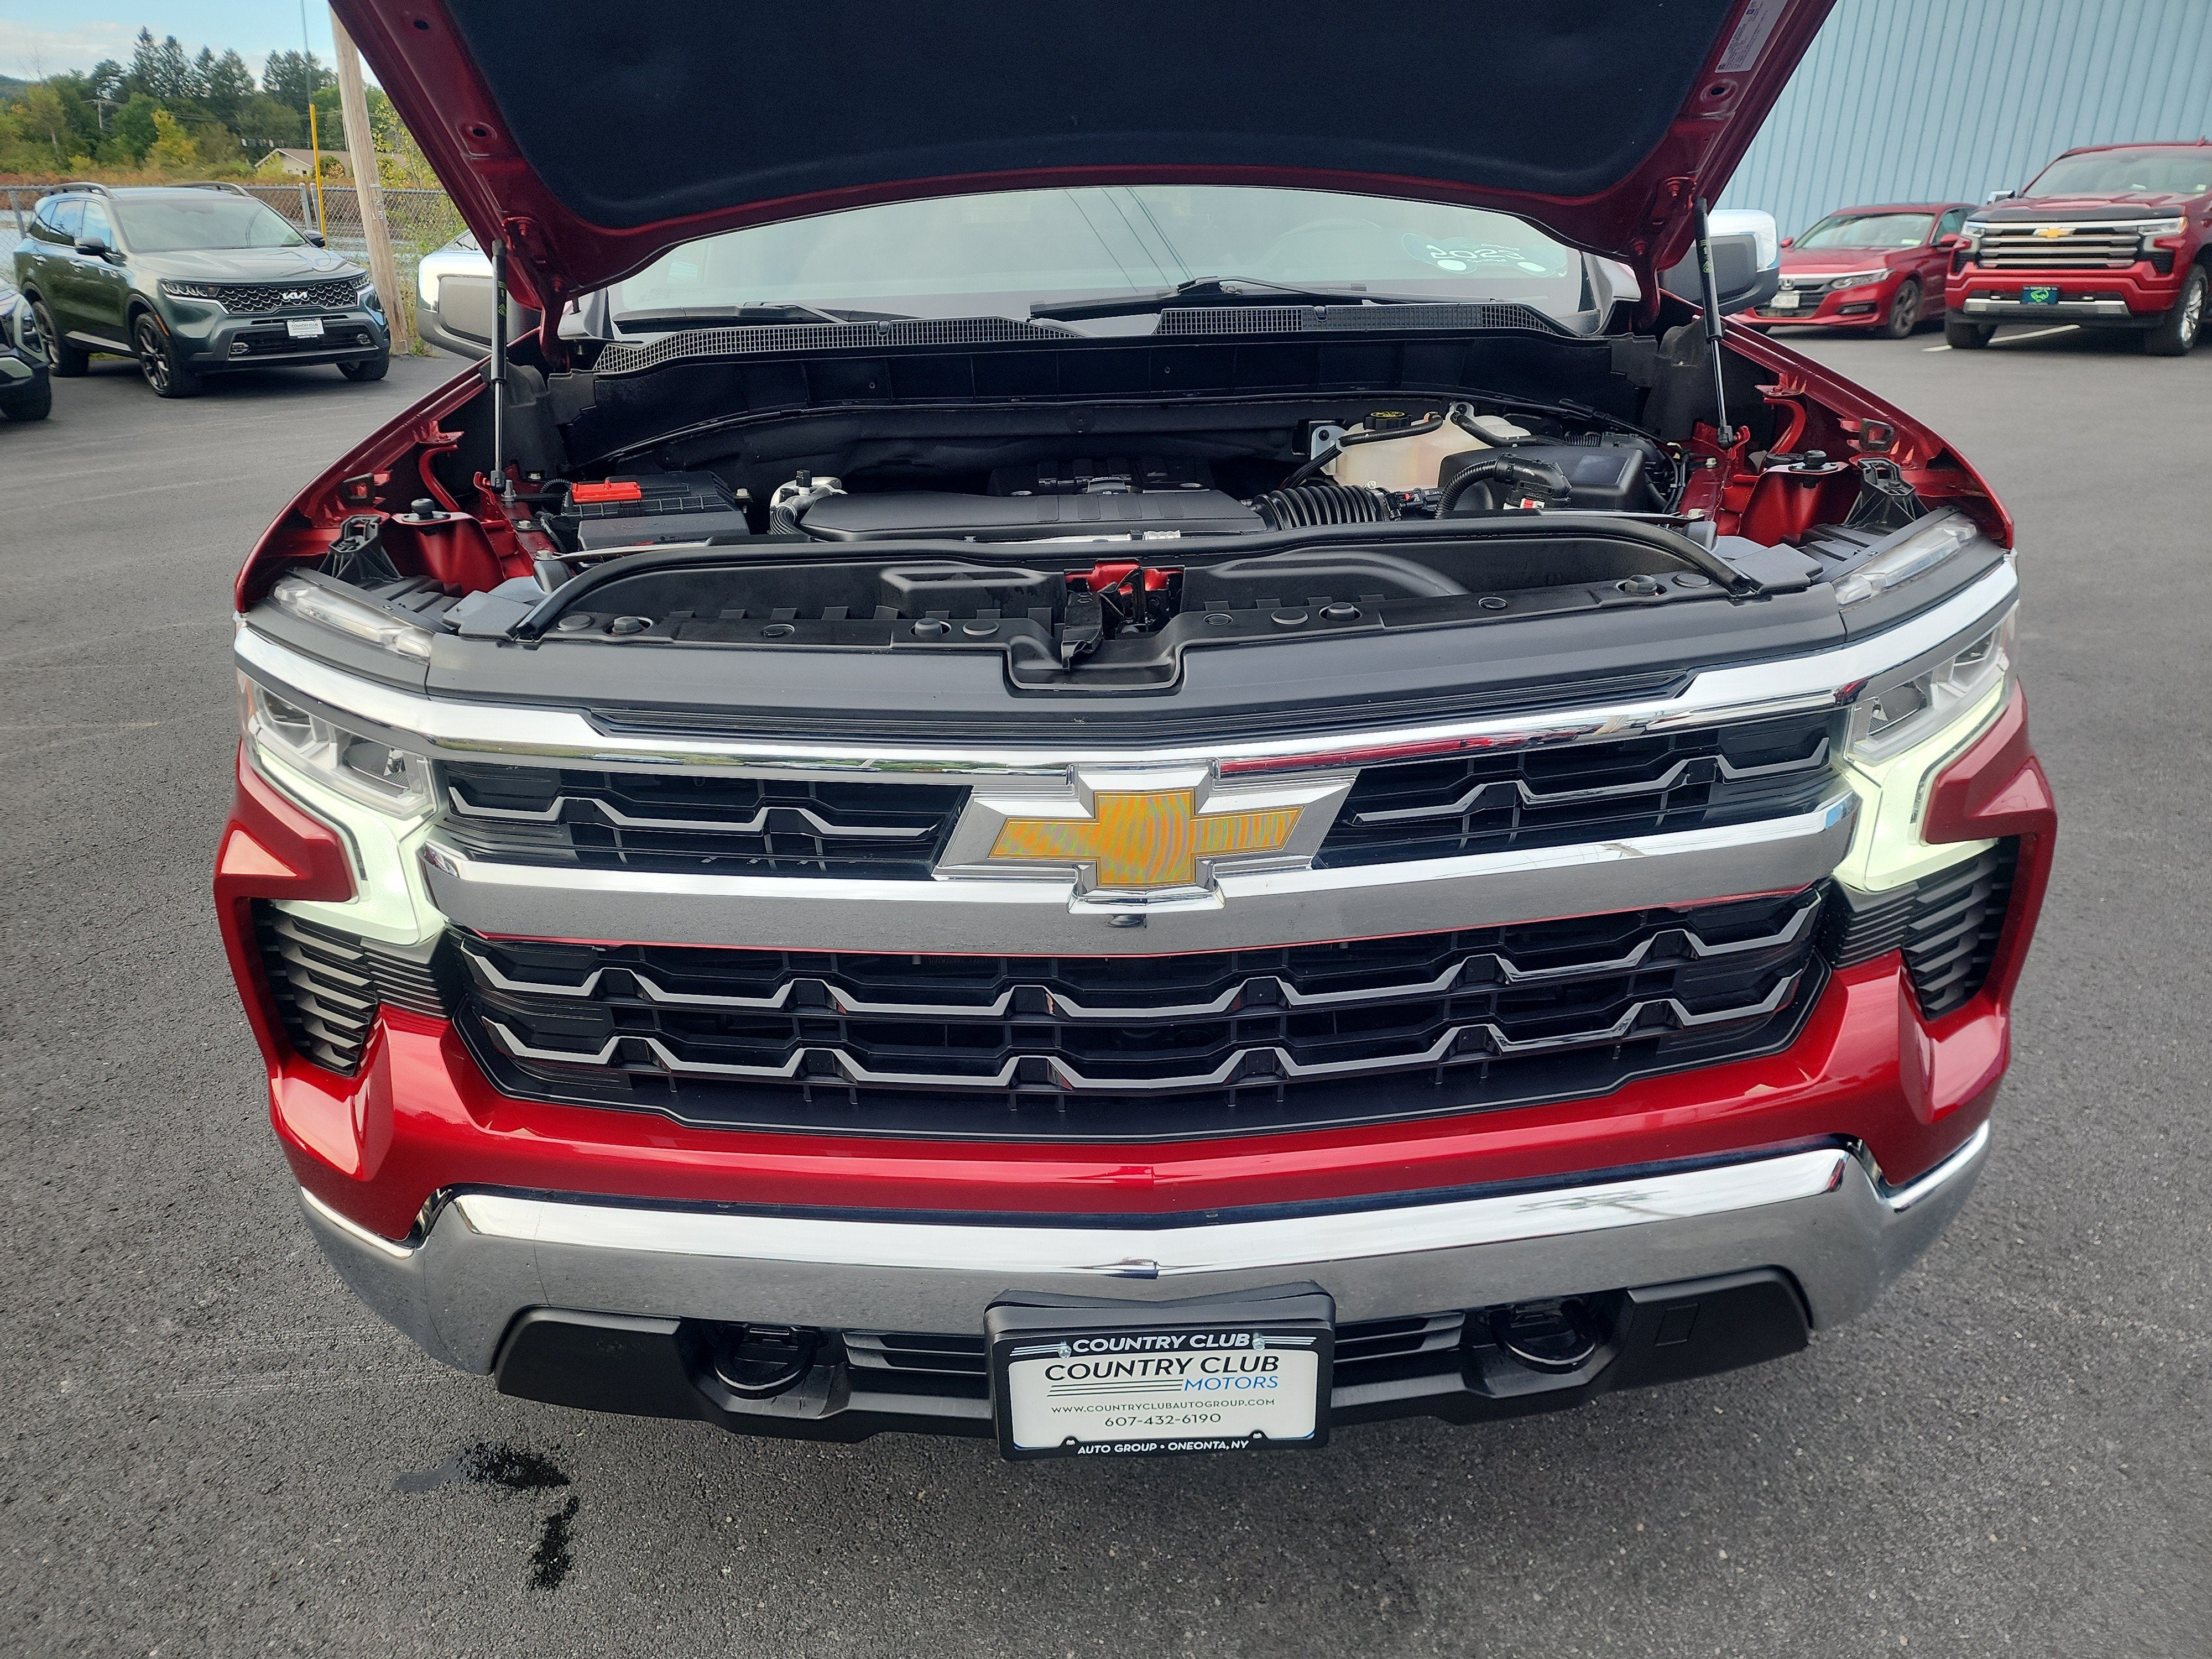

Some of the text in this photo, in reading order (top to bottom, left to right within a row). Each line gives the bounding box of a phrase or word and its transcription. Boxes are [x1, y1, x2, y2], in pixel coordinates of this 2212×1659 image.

[1426, 244, 1526, 260] 2023
[1073, 1333, 1250, 1353] COUNTRY CLUB
[1045, 1355, 1279, 1382] COUNTRY CLUB
[1184, 1375, 1279, 1391] MOTORS
[1051, 1399, 1275, 1413] WWW.COUNTRYCLUBAUTOGROUP.COM
[1105, 1413, 1221, 1427] 607-432-6190
[1077, 1442, 1111, 1455] AUTO
[1114, 1441, 1157, 1453] GROUP
